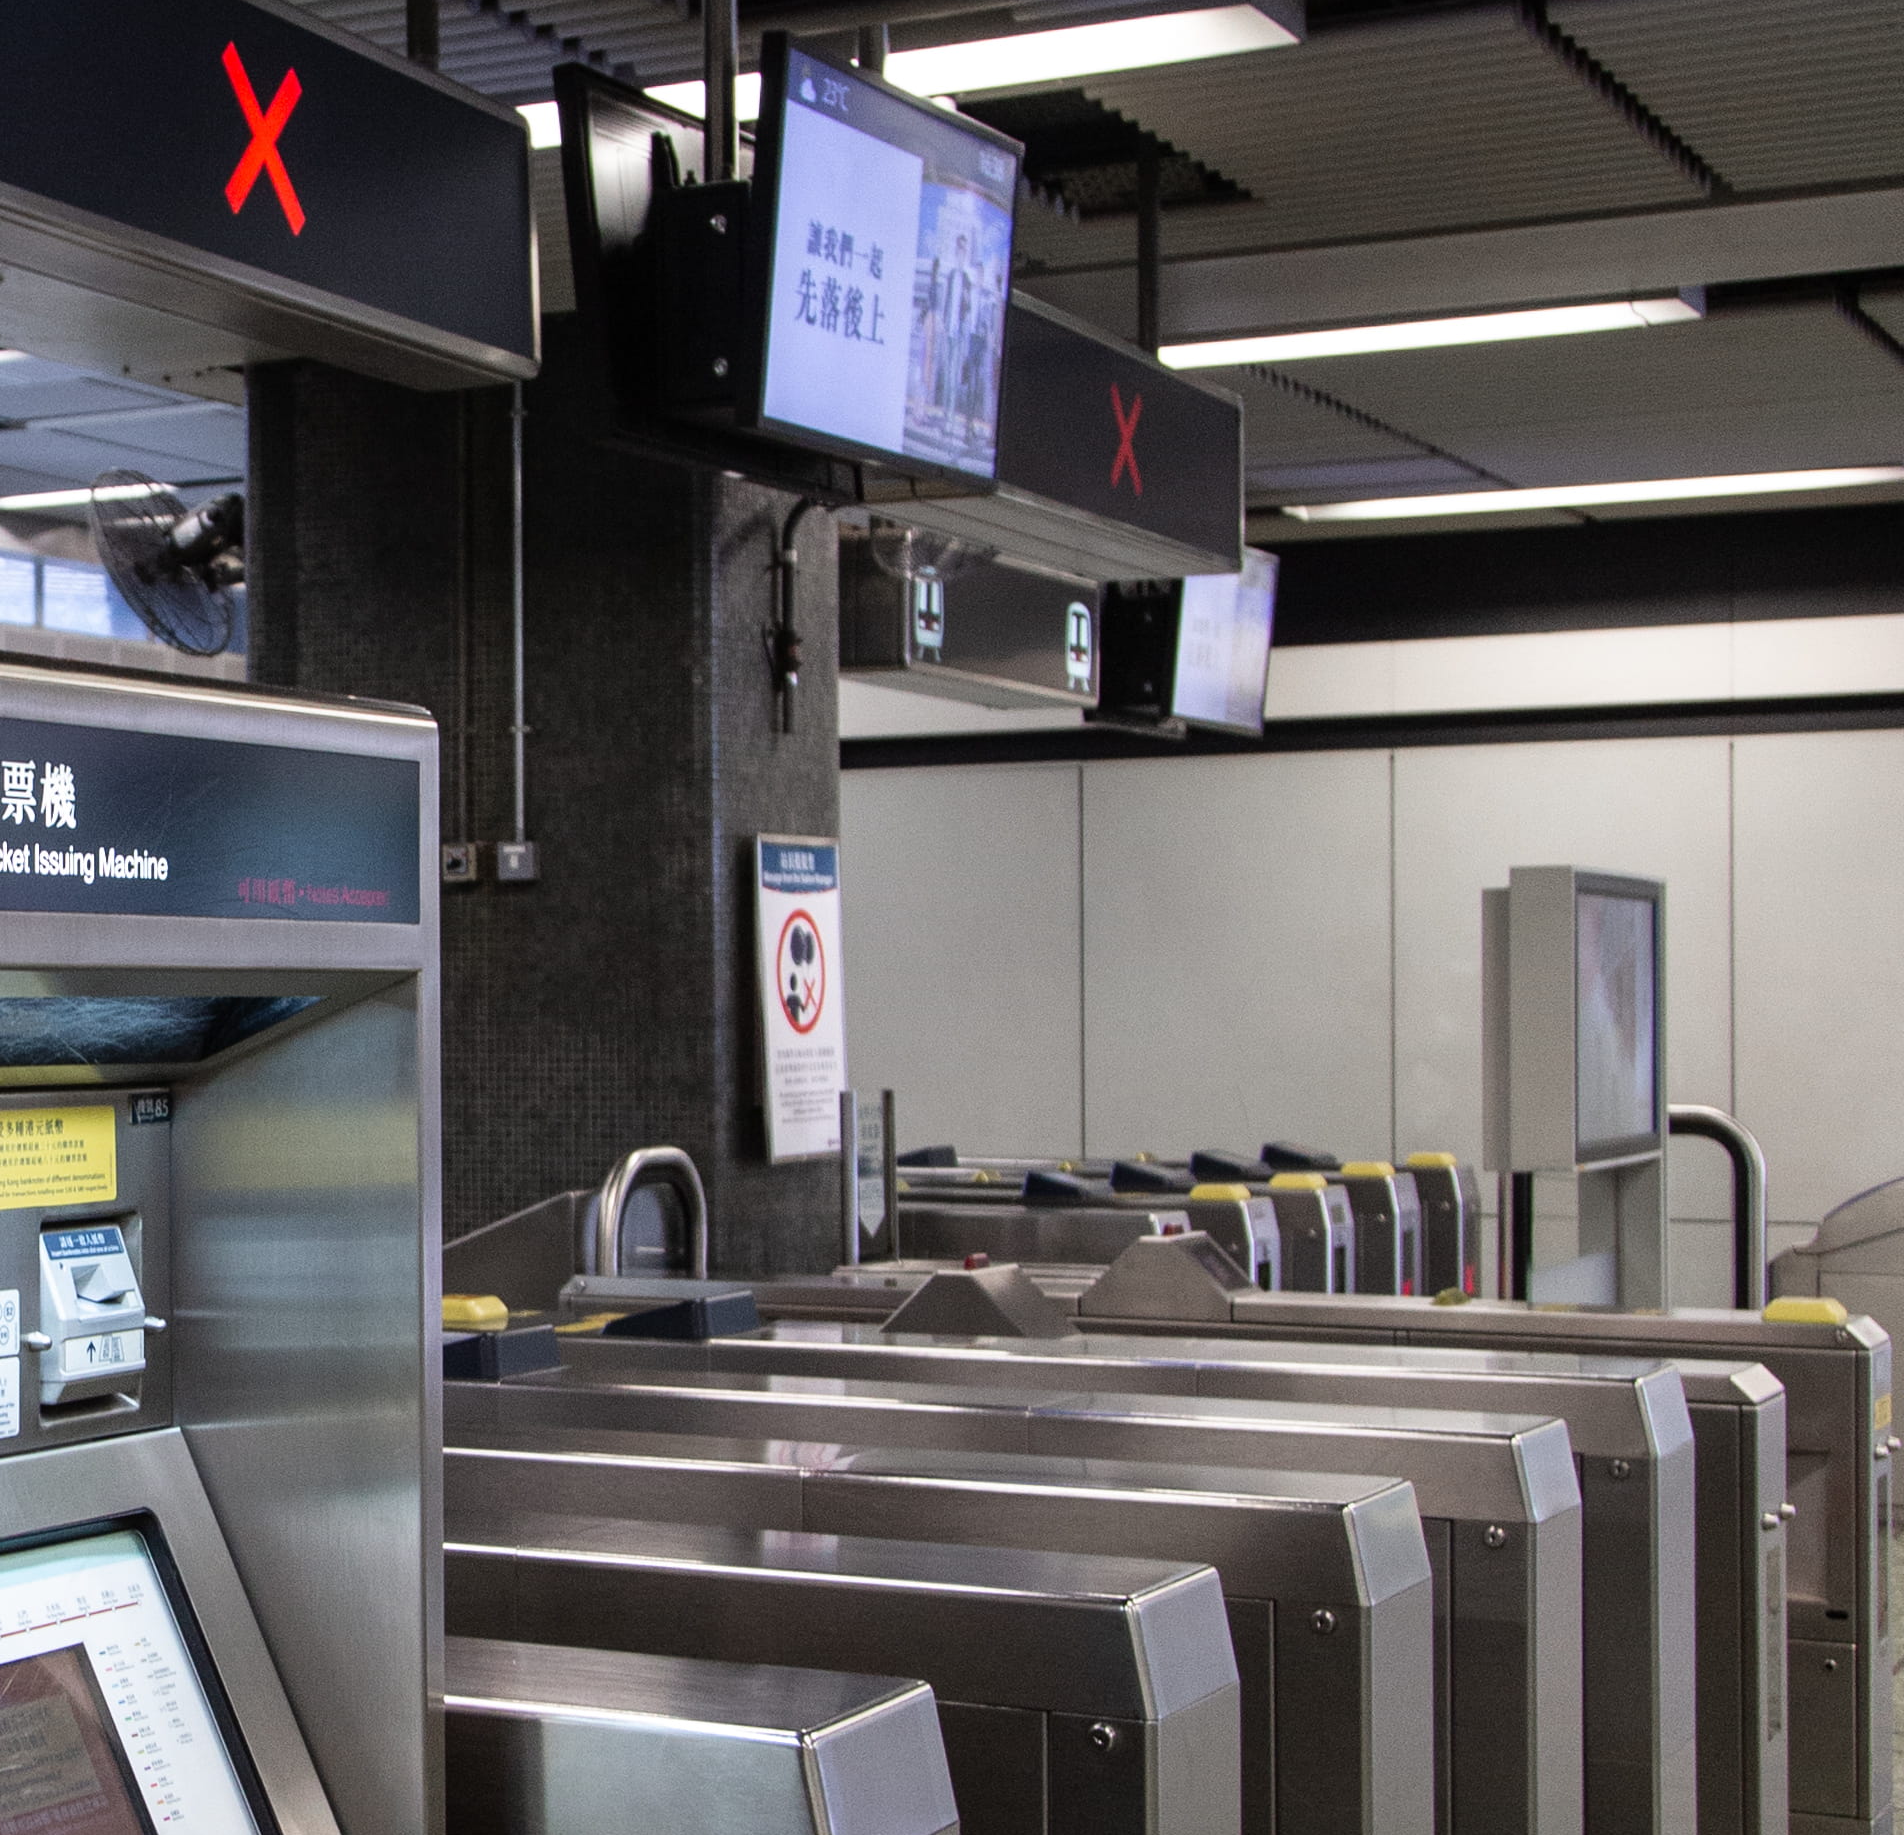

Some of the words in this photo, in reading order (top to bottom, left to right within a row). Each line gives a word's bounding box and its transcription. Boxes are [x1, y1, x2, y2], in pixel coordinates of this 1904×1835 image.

[807, 219, 885, 281] 讓我們一起
[795, 269, 885, 345] 先落後上
[34, 843, 95, 884] Issuing
[98, 847, 168, 880] Machine
